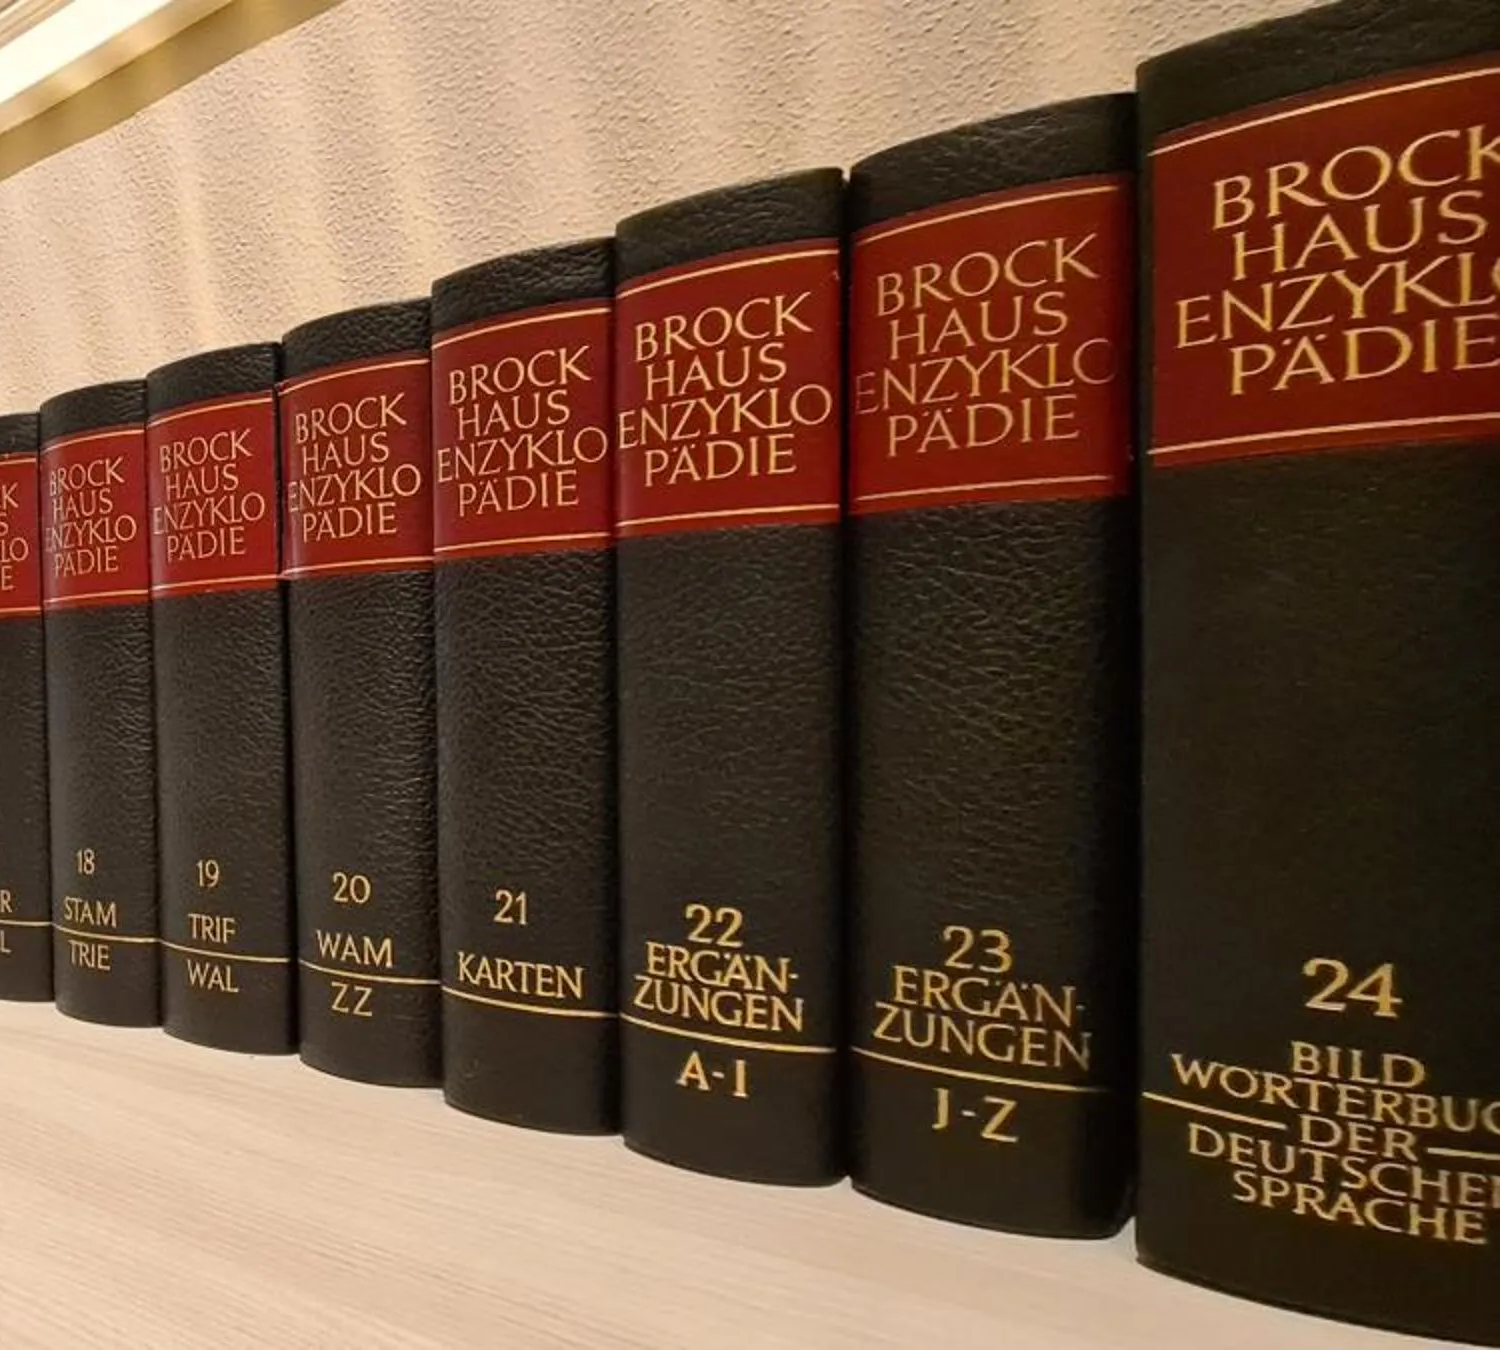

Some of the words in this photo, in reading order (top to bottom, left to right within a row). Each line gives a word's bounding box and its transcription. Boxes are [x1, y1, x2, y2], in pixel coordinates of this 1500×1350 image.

[1211, 124, 1500, 230] BROCK
[1231, 189, 1489, 281] HAUS
[876, 232, 1100, 317] BROCK
[1176, 252, 1500, 349] ENZYKL
[635, 291, 813, 362] BROCK
[889, 291, 1068, 360] HAUS
[450, 345, 592, 405] BROCK
[646, 342, 787, 401] HAUS
[856, 338, 1116, 415] ENZYKLO
[1229, 313, 1500, 396] PÄDIE
[295, 392, 407, 444] BROCK
[458, 389, 570, 441] HAUS
[618, 383, 833, 449] ENZYKLO
[887, 393, 1080, 457] PÄDIE
[160, 428, 253, 473] BROCK
[302, 431, 390, 475] HAUS
[437, 426, 608, 483] ENZYKLO
[644, 433, 797, 487] PÄDIE
[50, 456, 125, 496] BROCK
[166, 463, 239, 501] HAUS
[288, 463, 421, 513] ENZYKLO
[458, 469, 579, 517] PÄDIE
[53, 488, 113, 524] HAUS
[153, 491, 265, 535] ENZYKLO
[303, 501, 397, 543] PÄDIE
[45, 514, 137, 552] ENZYKLO
[167, 525, 246, 564] PÄDIE
[76, 848, 95, 875] 18
[196, 859, 220, 888] 19
[64, 896, 117, 928] STAM
[333, 871, 372, 904] 20
[493, 889, 528, 925] 21
[188, 913, 236, 944] TRIF
[316, 929, 394, 969] WAM
[685, 903, 744, 948] 22
[942, 925, 1013, 973] 23
[68, 939, 111, 971] TRIE
[187, 959, 239, 993] WAL
[457, 951, 586, 1000] KARTEN
[646, 941, 799, 994] ERGÄN-
[331, 981, 372, 1017] ZZ
[633, 974, 804, 1032] ZUNGEN
[893, 965, 1086, 1028] ERGÄN-
[1303, 957, 1403, 1018] 24
[873, 1001, 1093, 1072] ZUNGEN
[1291, 1040, 1426, 1089] BILD
[1299, 1113, 1419, 1162] DER
[1232, 1170, 1490, 1245] SPRACHE
